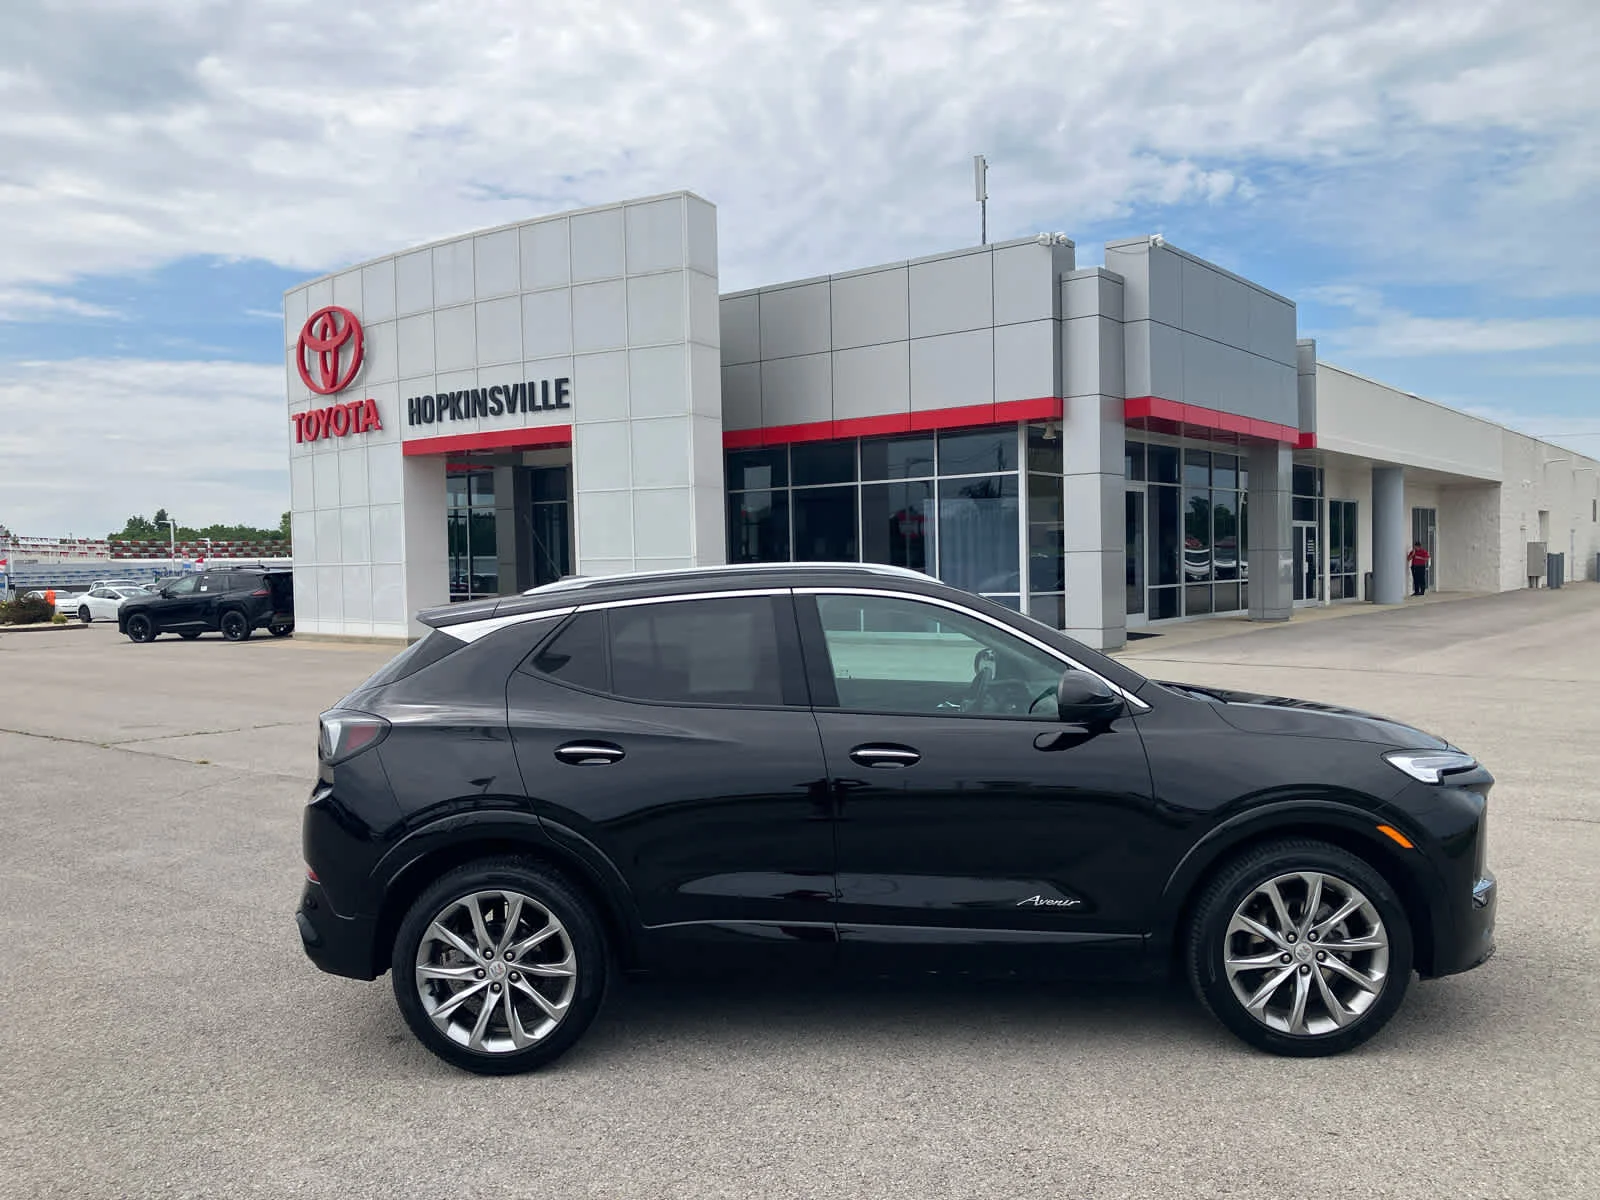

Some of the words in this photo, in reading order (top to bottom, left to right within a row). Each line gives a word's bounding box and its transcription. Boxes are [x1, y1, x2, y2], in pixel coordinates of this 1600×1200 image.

[292, 398, 383, 443] TOYOTA
[408, 377, 571, 426] HOPKINSVILLE
[1016, 895, 1081, 907] Avenir
